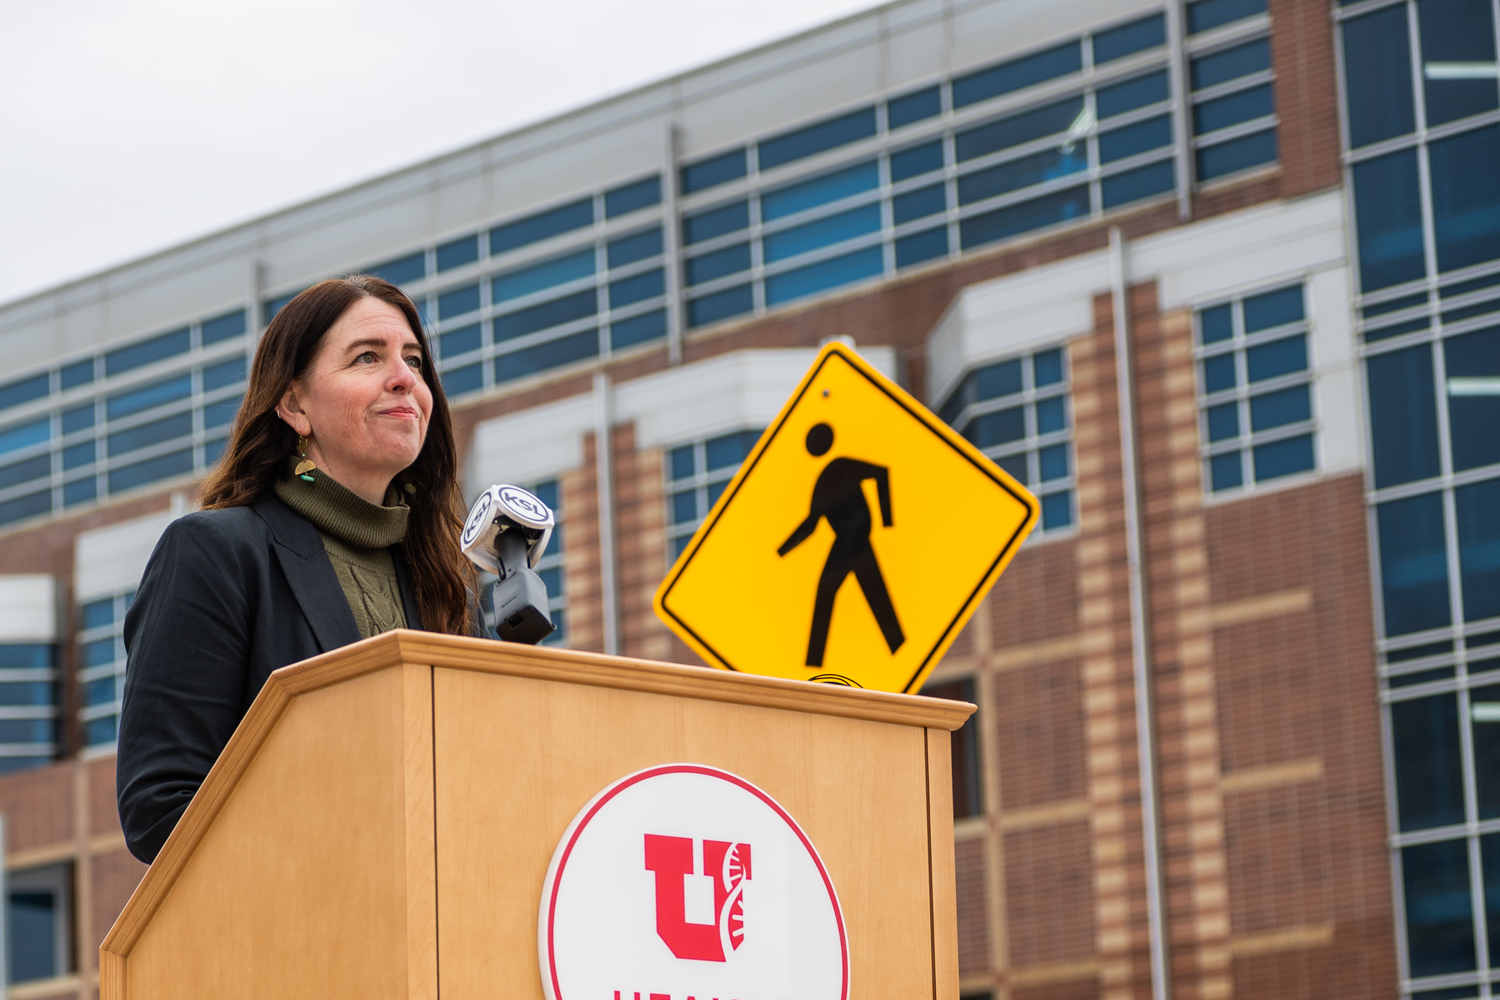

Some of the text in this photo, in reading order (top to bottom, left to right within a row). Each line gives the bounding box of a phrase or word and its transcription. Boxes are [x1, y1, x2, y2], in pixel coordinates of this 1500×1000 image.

[466, 501, 490, 538] KSL
[504, 491, 547, 519] KSL
[644, 833, 753, 963] U
